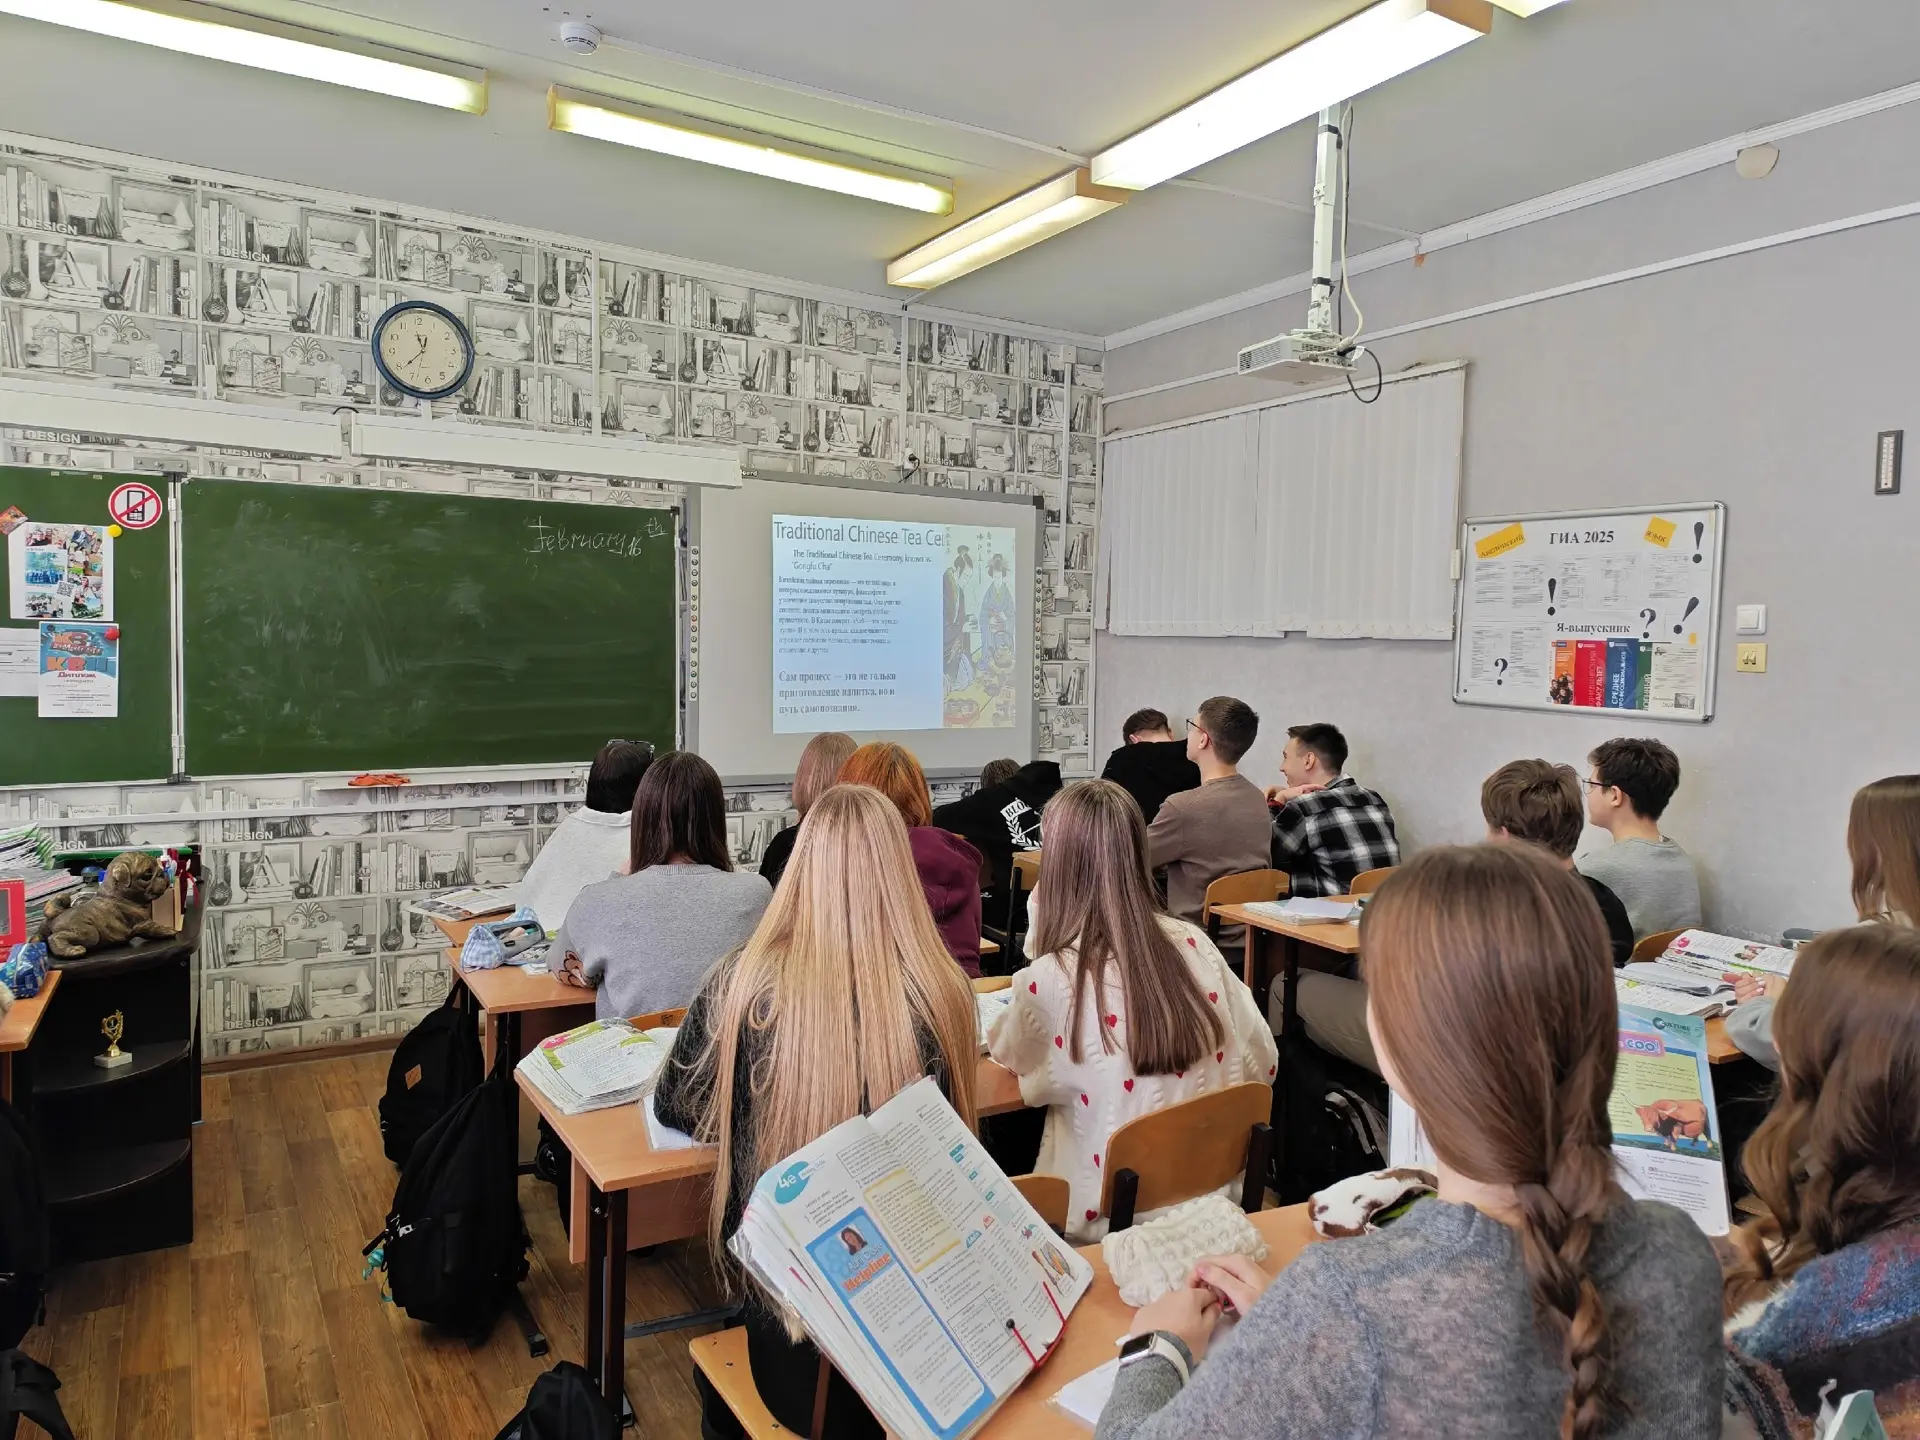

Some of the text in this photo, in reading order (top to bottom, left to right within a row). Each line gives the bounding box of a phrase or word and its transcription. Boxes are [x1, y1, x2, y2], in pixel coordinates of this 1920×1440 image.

[774, 521, 844, 542] Traditional
[848, 525, 898, 544] Chinese
[902, 528, 922, 545] Tea
[1549, 531, 1614, 545] ГИА 2025
[793, 549, 804, 558] The
[806, 550, 838, 560] Traditional
[839, 551, 862, 561] Chinese
[863, 553, 873, 561] Tea
[905, 554, 923, 563] known
[1556, 622, 1630, 635] Я-выпускник
[779, 670, 797, 682] Сам
[799, 673, 831, 684] процесс
[844, 673, 857, 681] это
[870, 673, 896, 681] только
[779, 688, 840, 700] приготовление
[1611, 673, 1620, 704] СРЕДНЕЕ
[779, 704, 860, 716] путь самопознания.
